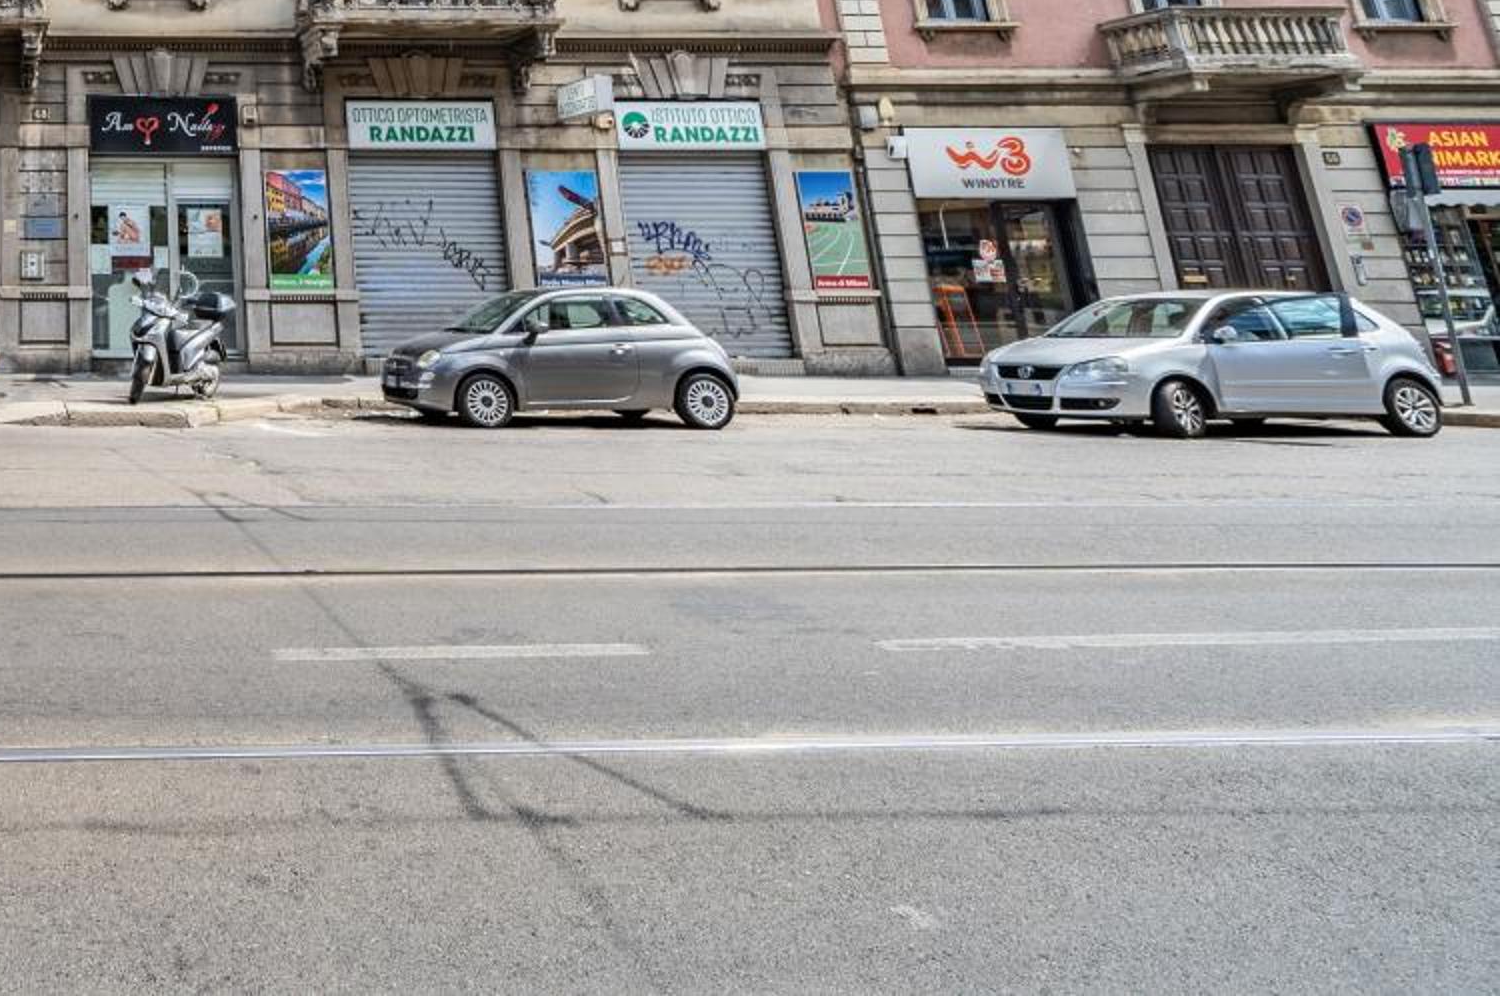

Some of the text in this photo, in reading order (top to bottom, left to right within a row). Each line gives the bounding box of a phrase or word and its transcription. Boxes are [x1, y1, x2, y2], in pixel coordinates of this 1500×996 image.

[352, 107, 489, 124] OTTICO OPTOMETRISTA
[651, 107, 758, 124] ISTITUTO OTTICO
[369, 125, 476, 142] RANDAZZI
[654, 125, 760, 142] RANDAZZI
[1428, 131, 1489, 147] ASIAN
[961, 177, 1025, 189] WINDTRE
